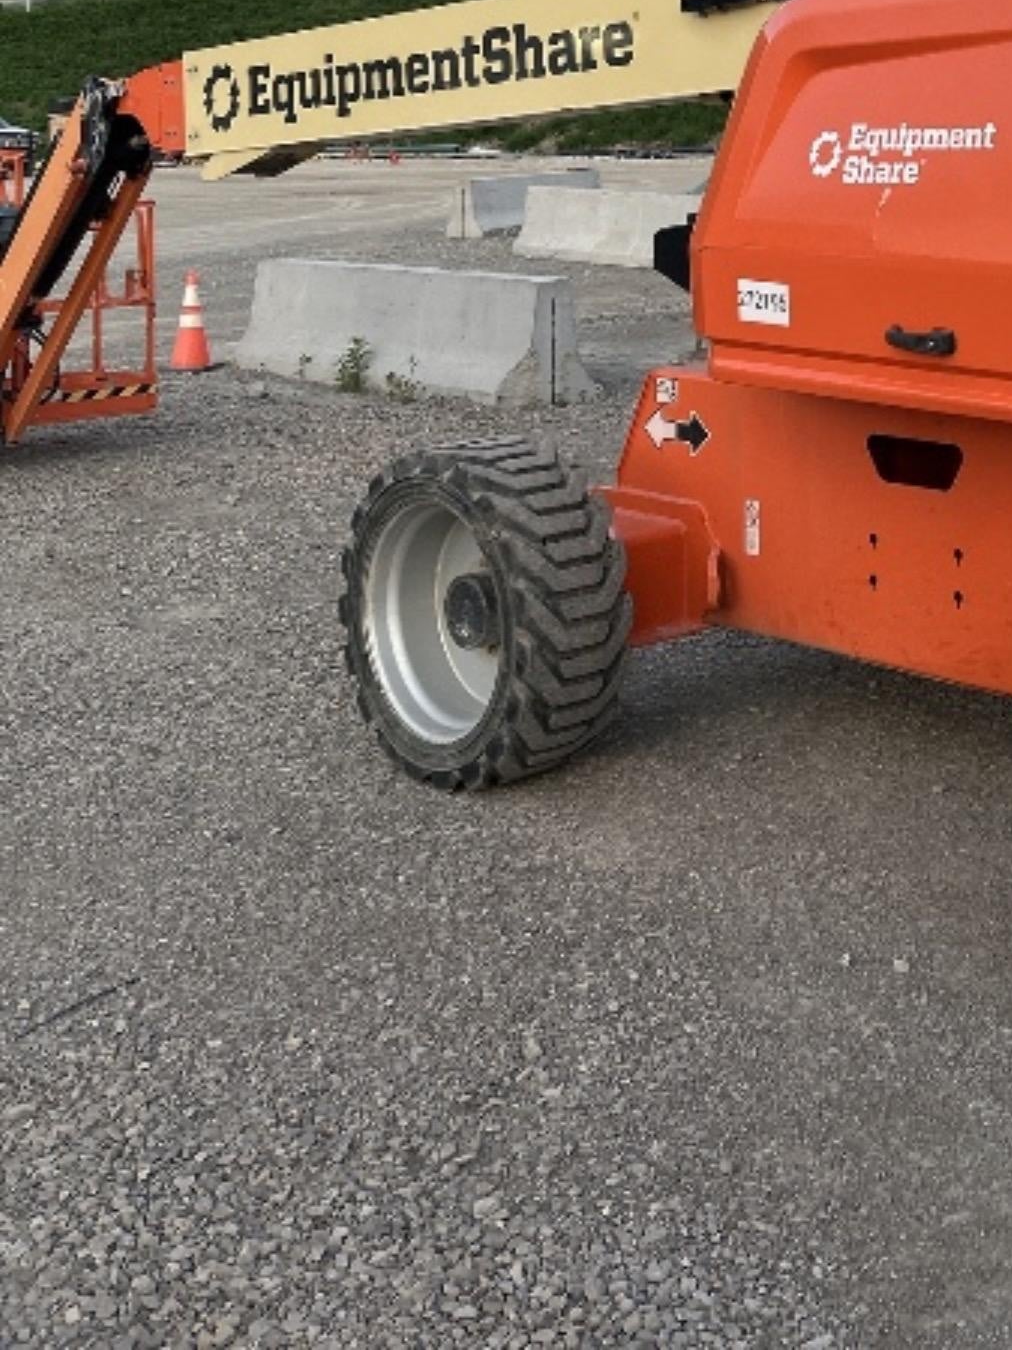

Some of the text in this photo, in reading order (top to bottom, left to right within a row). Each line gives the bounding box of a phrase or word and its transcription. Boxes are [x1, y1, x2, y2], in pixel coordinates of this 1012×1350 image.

[247, 19, 634, 125] EquipmentShare
[848, 121, 996, 156] Equipment
[842, 156, 919, 185] Share
